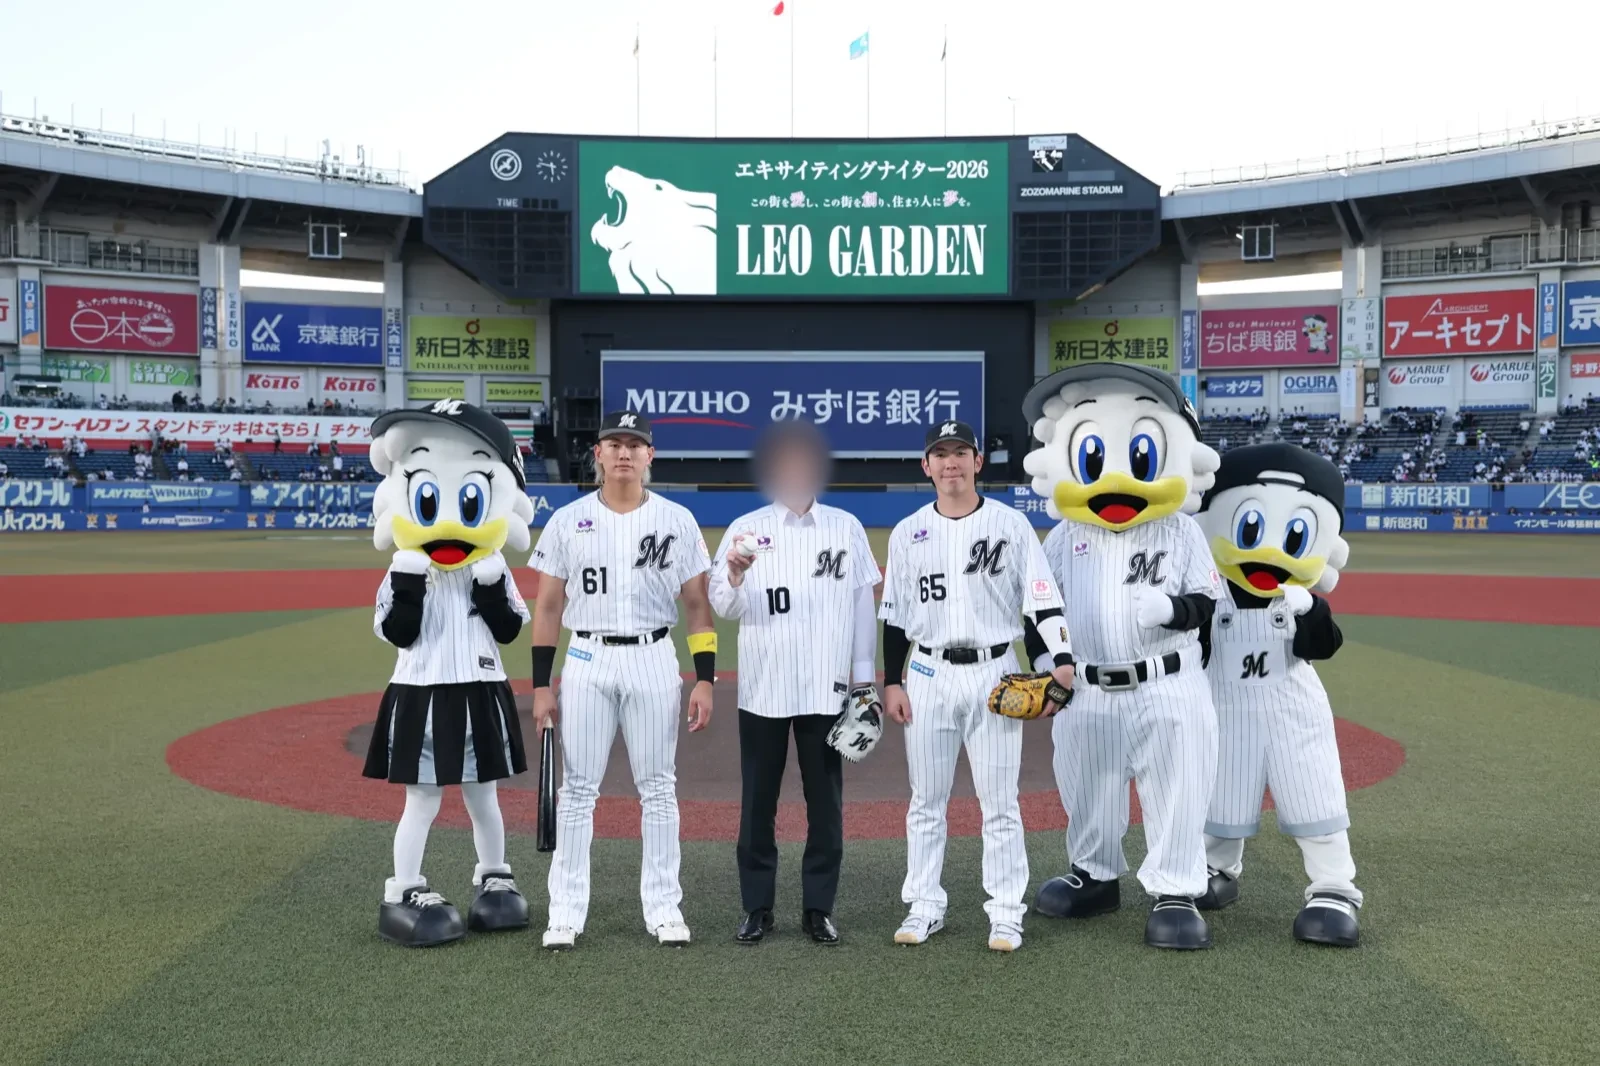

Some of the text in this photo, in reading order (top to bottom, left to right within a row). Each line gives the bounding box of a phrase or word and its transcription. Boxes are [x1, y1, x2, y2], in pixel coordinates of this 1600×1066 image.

[735, 160, 988, 180] エキサイティングナイター2026
[497, 198, 518, 207] TIME
[1020, 185, 1123, 197] ZOZOMARINE STADIUM
[736, 224, 987, 277] LEO GARDEN
[298, 324, 380, 347] 京葉銀行
[1183, 315, 1192, 364] グループ
[1205, 330, 1297, 353] ちば興銀
[1388, 312, 1532, 349] アーキセプト
[252, 342, 280, 352] BANK
[415, 336, 530, 360] 新日本建設
[1054, 337, 1169, 360] 新日本建設
[416, 362, 530, 371] INTELLIGENT DEVELOPER
[1406, 364, 1449, 375] MARUEI
[1489, 361, 1534, 372] MARUEI
[1492, 372, 1530, 382] Group
[1572, 362, 1600, 375] 宇野
[1226, 379, 1262, 395] オグラ
[1284, 375, 1338, 389] OGURA
[1409, 375, 1444, 385] Group
[1540, 361, 1554, 397] ホクト
[626, 388, 750, 414] MIZUHO
[770, 388, 960, 425] みずほ銀行
[1391, 486, 1470, 506] 新昭和
[0, 513, 65, 530] ハイスクール
[1383, 516, 1428, 530] 新昭和
[632, 531, 678, 571] M
[963, 536, 1010, 577] M
[811, 547, 848, 581] M
[1123, 549, 1168, 587] M
[582, 567, 607, 595] 61
[919, 573, 947, 604] 65
[766, 586, 791, 616] 10
[1240, 651, 1269, 679] M
